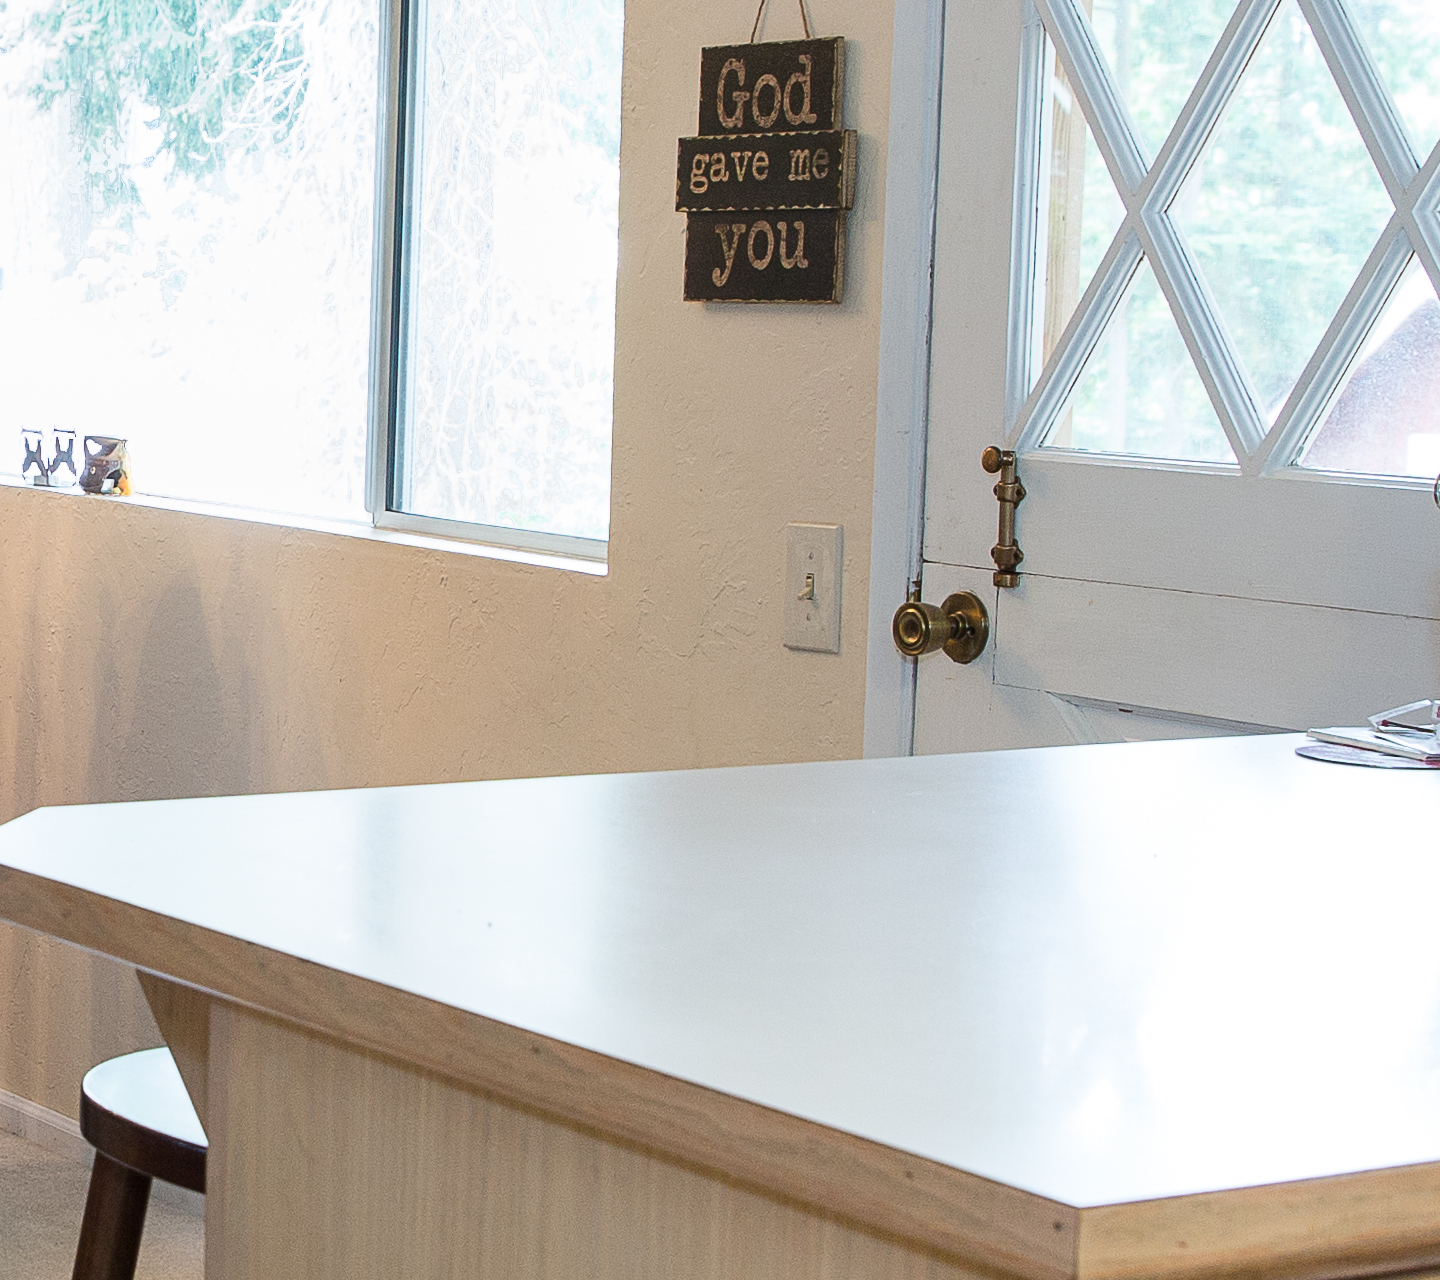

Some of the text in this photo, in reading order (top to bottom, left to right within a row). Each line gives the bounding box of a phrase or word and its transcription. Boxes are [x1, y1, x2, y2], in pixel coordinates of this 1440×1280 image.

[717, 54, 817, 129] God
[690, 148, 830, 194] gave me
[712, 220, 809, 287] you
